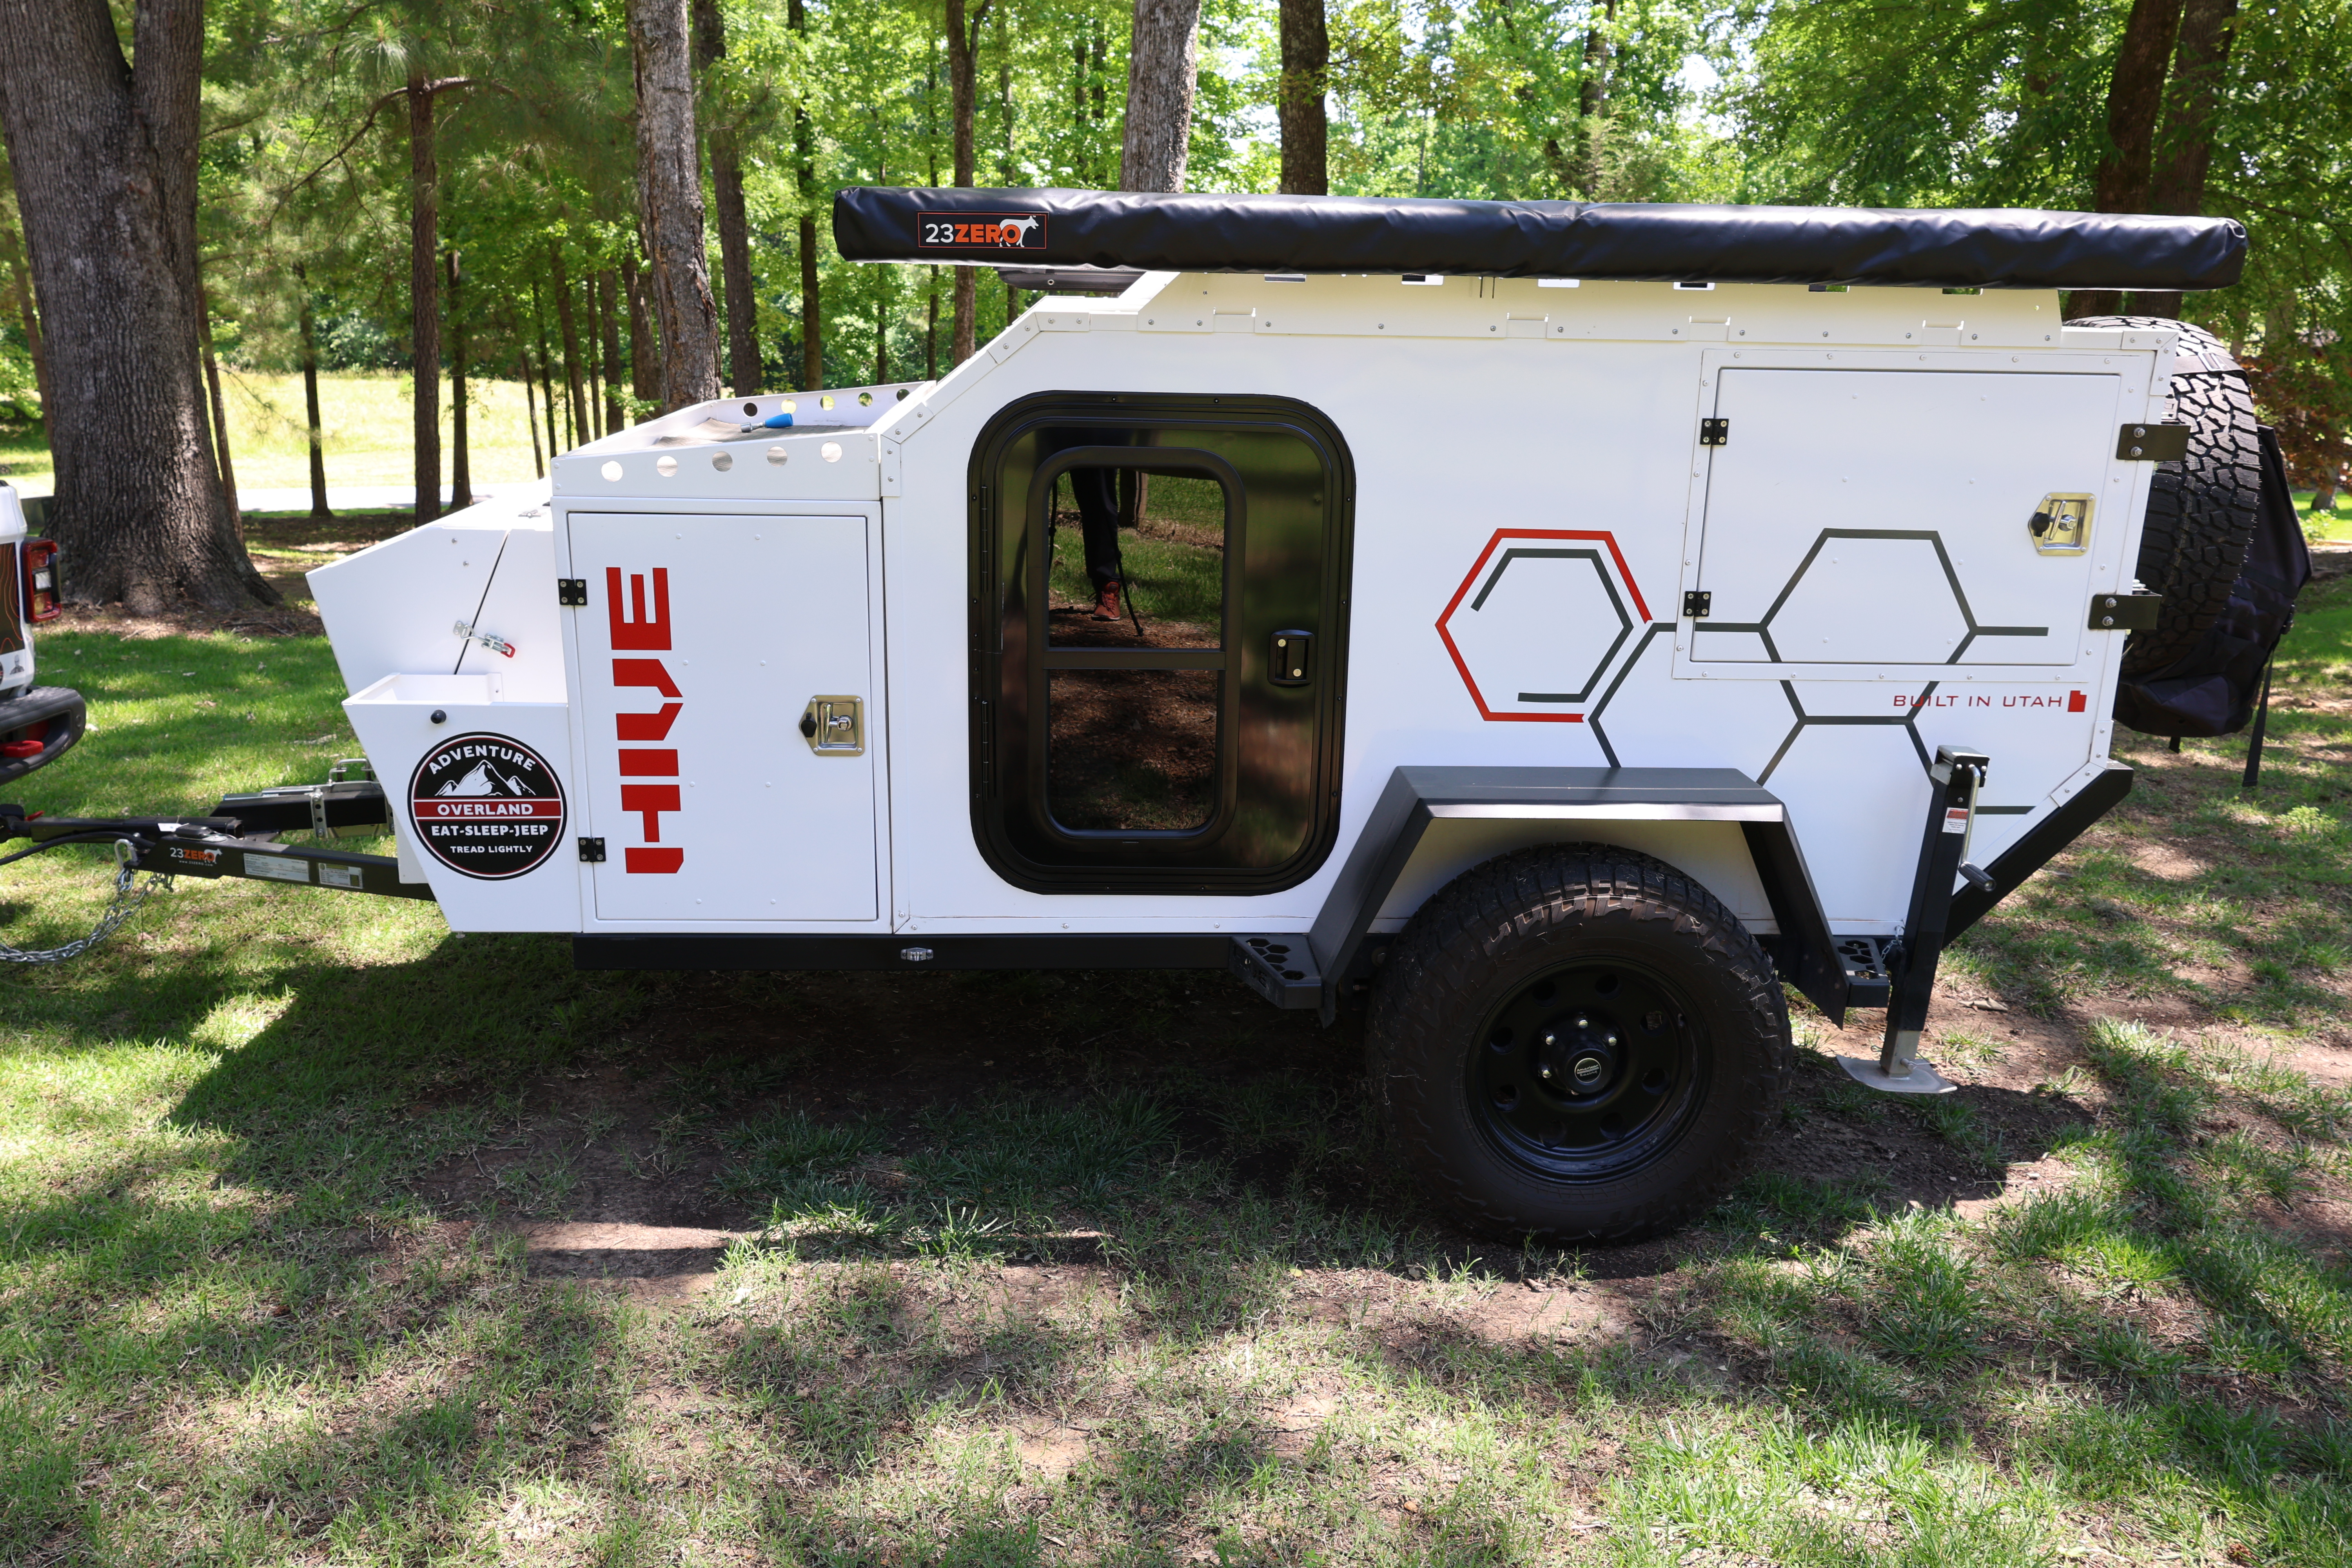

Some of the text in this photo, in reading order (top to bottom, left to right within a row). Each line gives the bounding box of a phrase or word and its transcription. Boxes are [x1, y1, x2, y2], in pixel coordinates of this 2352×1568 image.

[925, 223, 1021, 243] 23ZERO
[1893, 695, 2063, 708] BUILT IN UTAH
[606, 566, 684, 874] HIVE
[428, 745, 536, 775] ADVENTURE
[437, 804, 534, 816] OVERLAND
[431, 824, 549, 837] EAT-SLEEP-JEEP
[169, 847, 214, 862] 23ZERO
[488, 845, 533, 853] LIGHTLY
[1576, 1064, 1599, 1072] American
